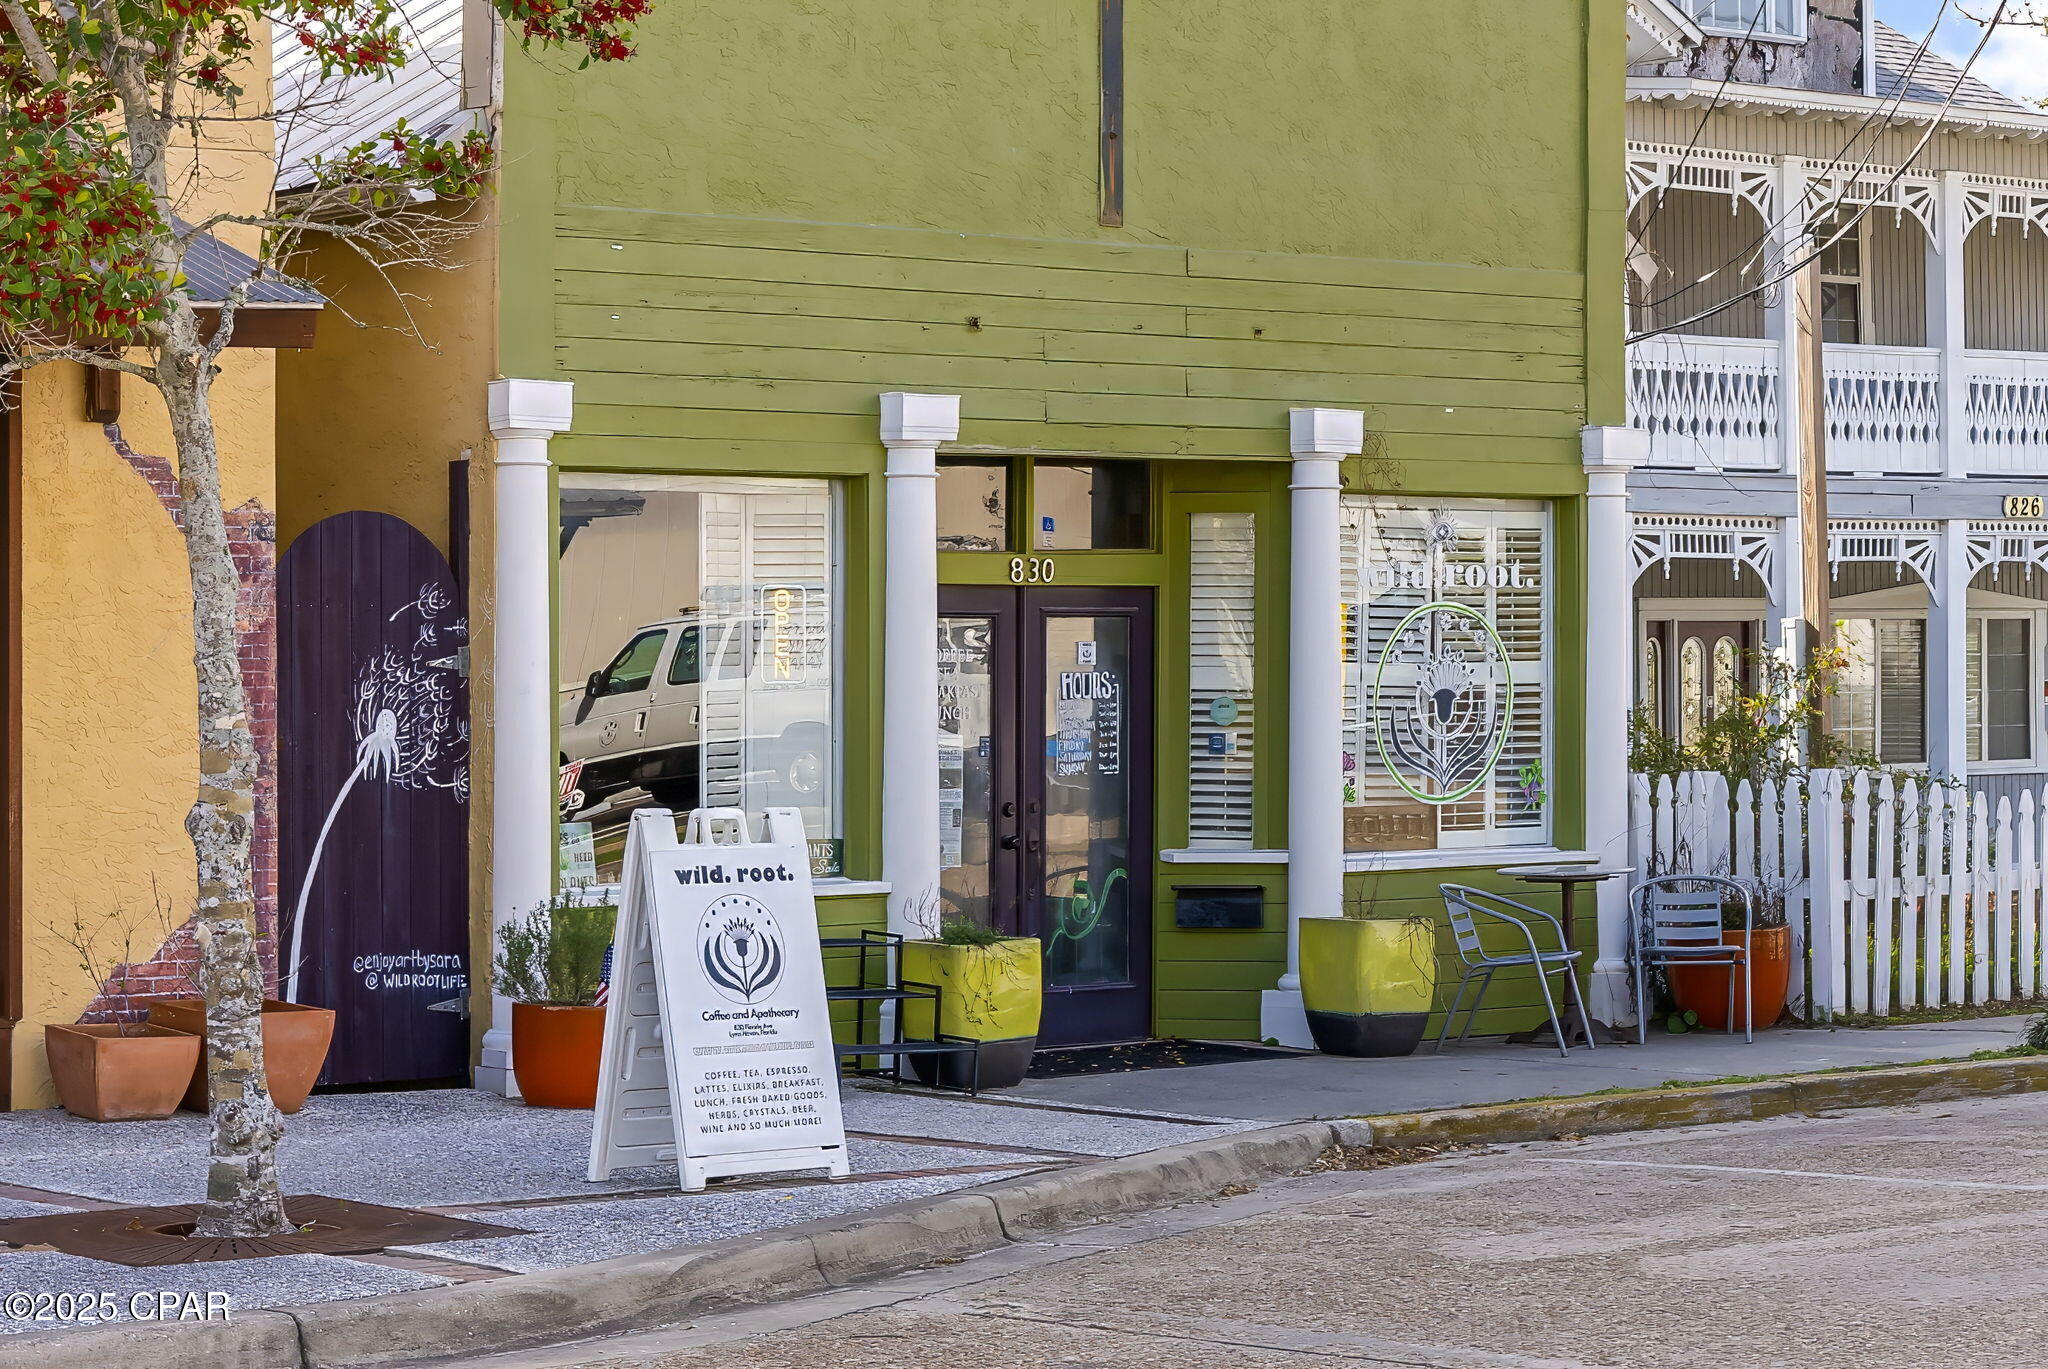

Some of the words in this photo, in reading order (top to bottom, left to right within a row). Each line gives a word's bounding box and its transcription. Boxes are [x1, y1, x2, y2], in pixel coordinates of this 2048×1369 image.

[2010, 497, 2040, 517] 826
[1009, 557, 1055, 583] 830
[1444, 558, 1536, 589] root.
[774, 589, 791, 680] OPEN
[1061, 671, 1116, 700] HOURS:
[674, 864, 732, 885] wild.
[737, 863, 794, 883] root.
[353, 949, 461, 973] @enjoyartbysara
[702, 1010, 731, 1021] Coffee
[732, 1009, 750, 1020] and
[751, 1008, 800, 1020] Apothecary
[743, 1069, 763, 1078] TEA,
[694, 1084, 729, 1095] LATTES,
[772, 1078, 824, 1089] BREAKFAST,
[694, 1098, 728, 1108] LUNCH,
[731, 1095, 759, 1105] FRESH
[762, 1093, 790, 1103] BAKED
[794, 1090, 827, 1101] GOODS,
[743, 1106, 789, 1118] CRYSTALS,
[700, 1124, 724, 1134] WINE
[727, 1123, 747, 1132] AND
[749, 1121, 761, 1130] SO
[764, 1119, 790, 1129] MUCH
[793, 1116, 822, 1126] MORE!
